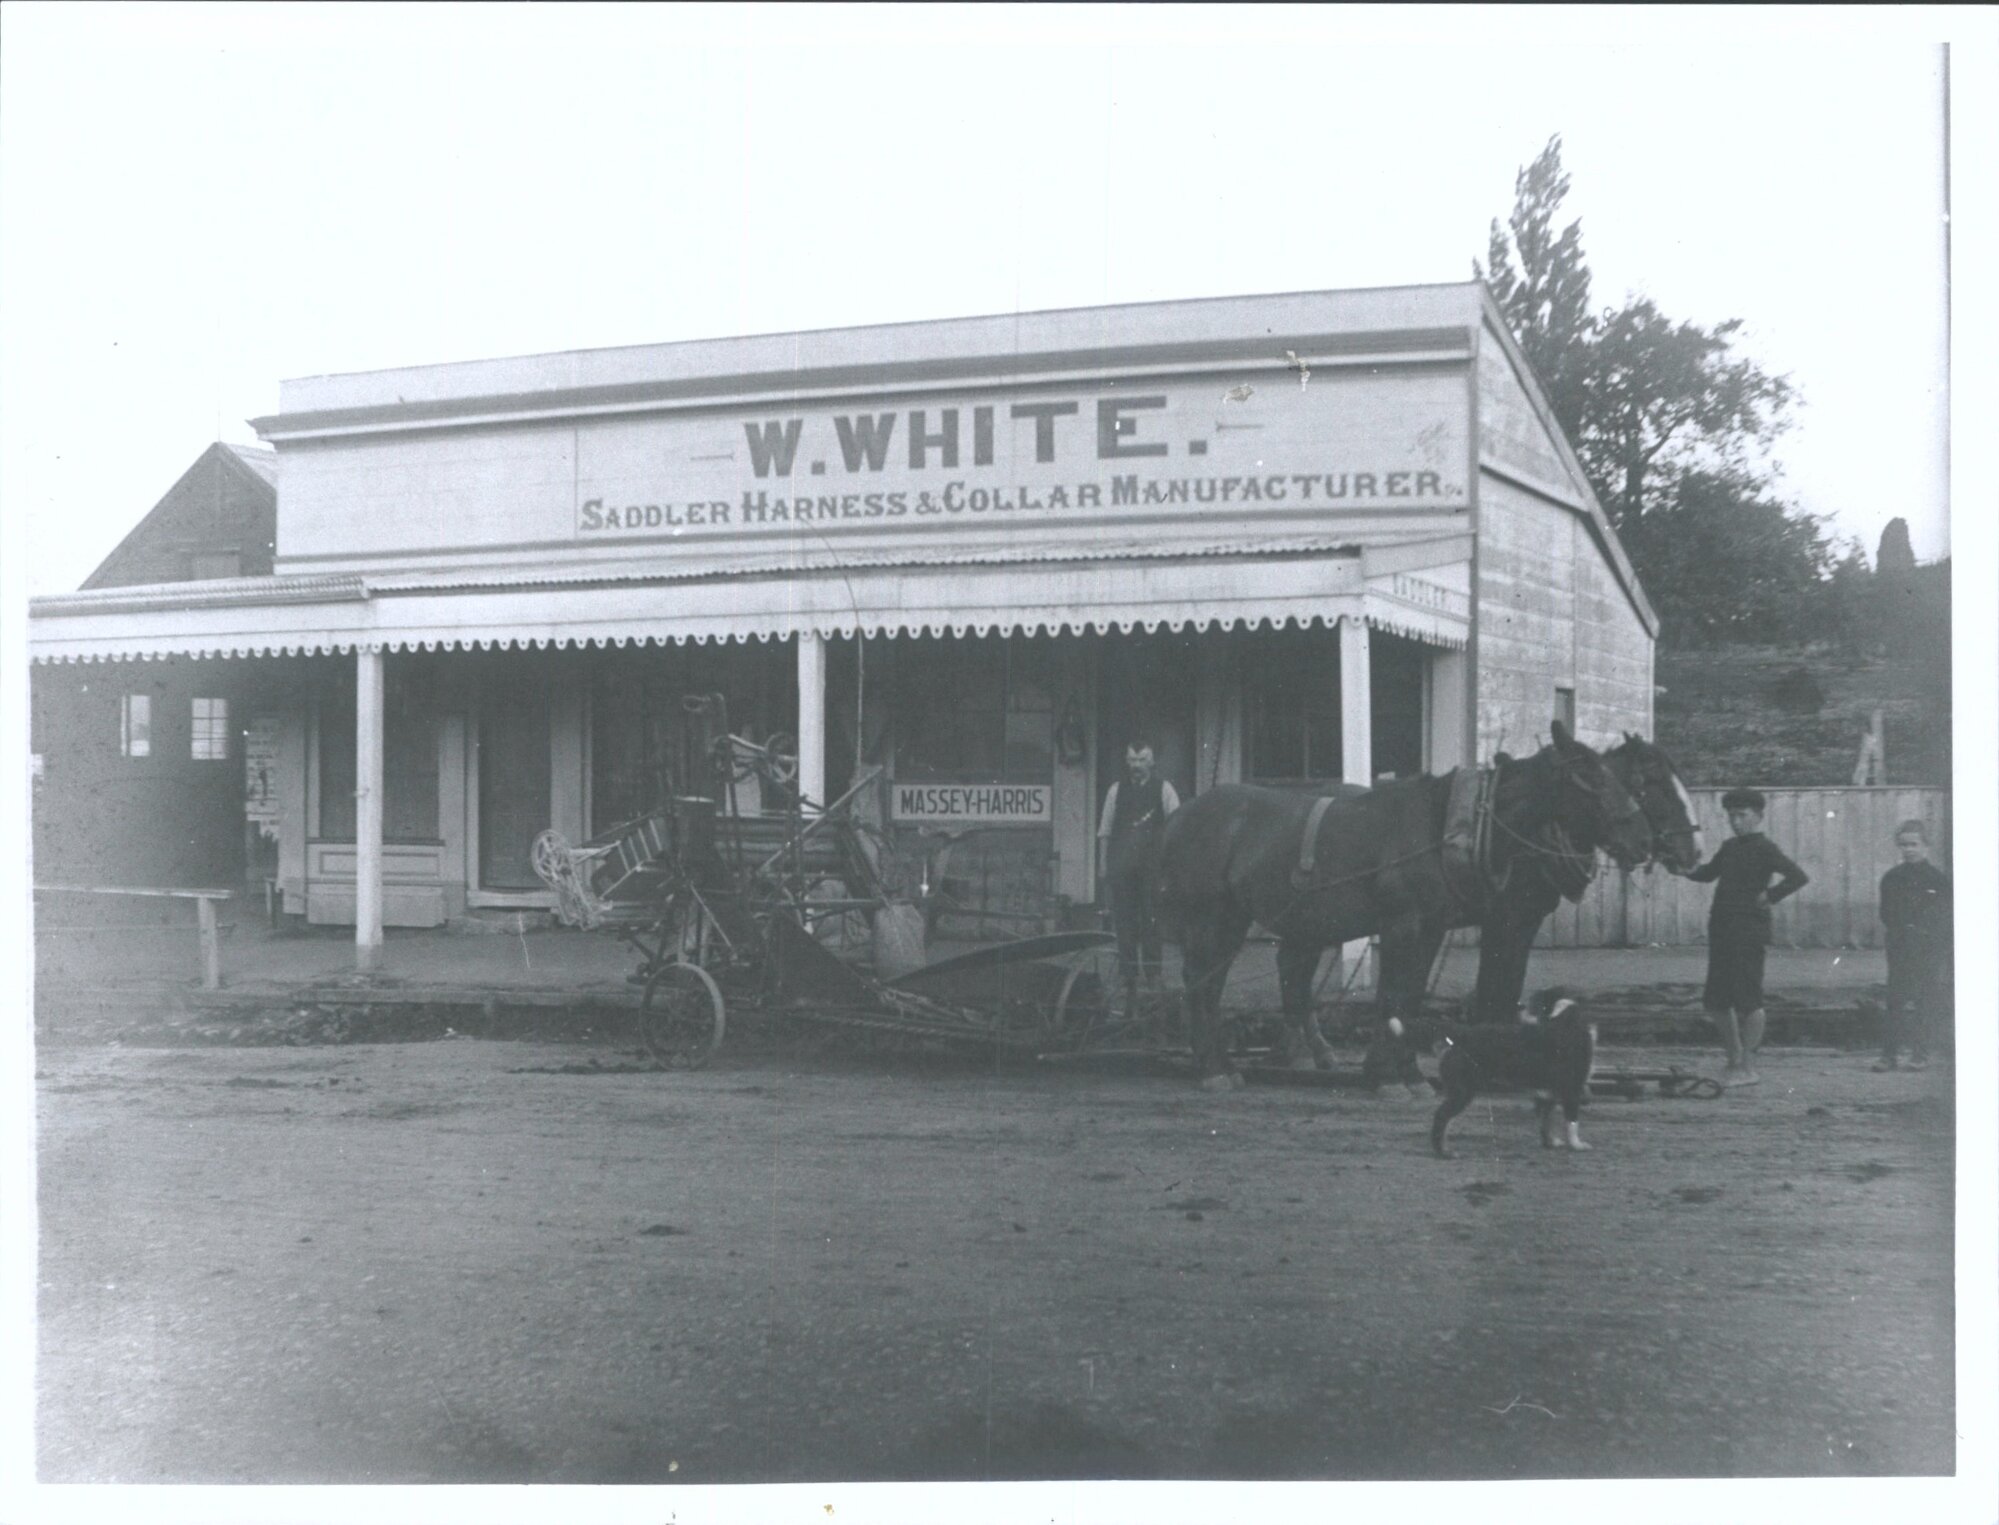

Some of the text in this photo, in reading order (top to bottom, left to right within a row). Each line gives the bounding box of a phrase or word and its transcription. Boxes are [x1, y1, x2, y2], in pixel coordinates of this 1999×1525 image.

[580, 498, 731, 530] SADDLER
[742, 491, 908, 523] HARNESS
[914, 490, 942, 515] &
[942, 480, 1103, 514] COLLAR
[901, 788, 1045, 815] MASSEY-HARRIS
